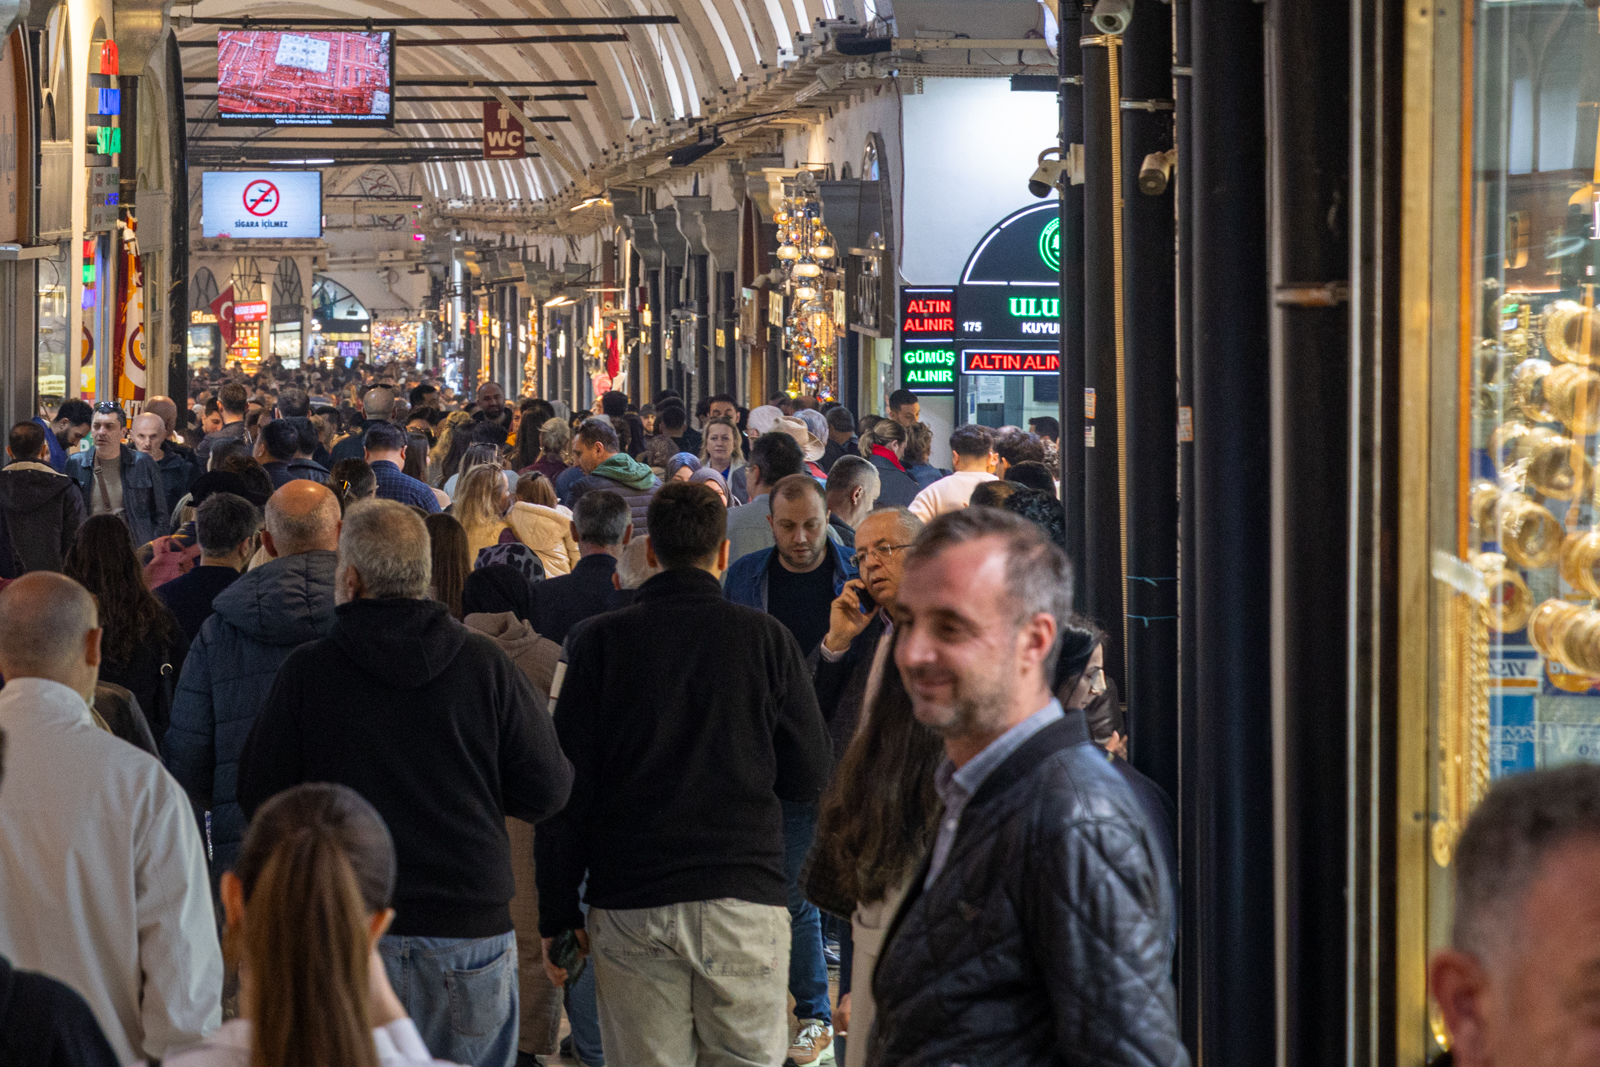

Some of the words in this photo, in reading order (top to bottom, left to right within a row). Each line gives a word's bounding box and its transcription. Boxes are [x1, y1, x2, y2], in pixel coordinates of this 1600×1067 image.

[487, 131, 522, 147] WC
[234, 219, 259, 228] SİGARA
[261, 219, 288, 230] İÇİLMEZ
[907, 300, 952, 314] ALTIN
[903, 318, 955, 332] ALINIR
[962, 321, 982, 332] 175
[1021, 321, 1060, 334] KUYU
[904, 350, 956, 367] GÜMÜŞ
[970, 354, 1020, 370] ALTIN
[906, 370, 953, 383] ALINIR
